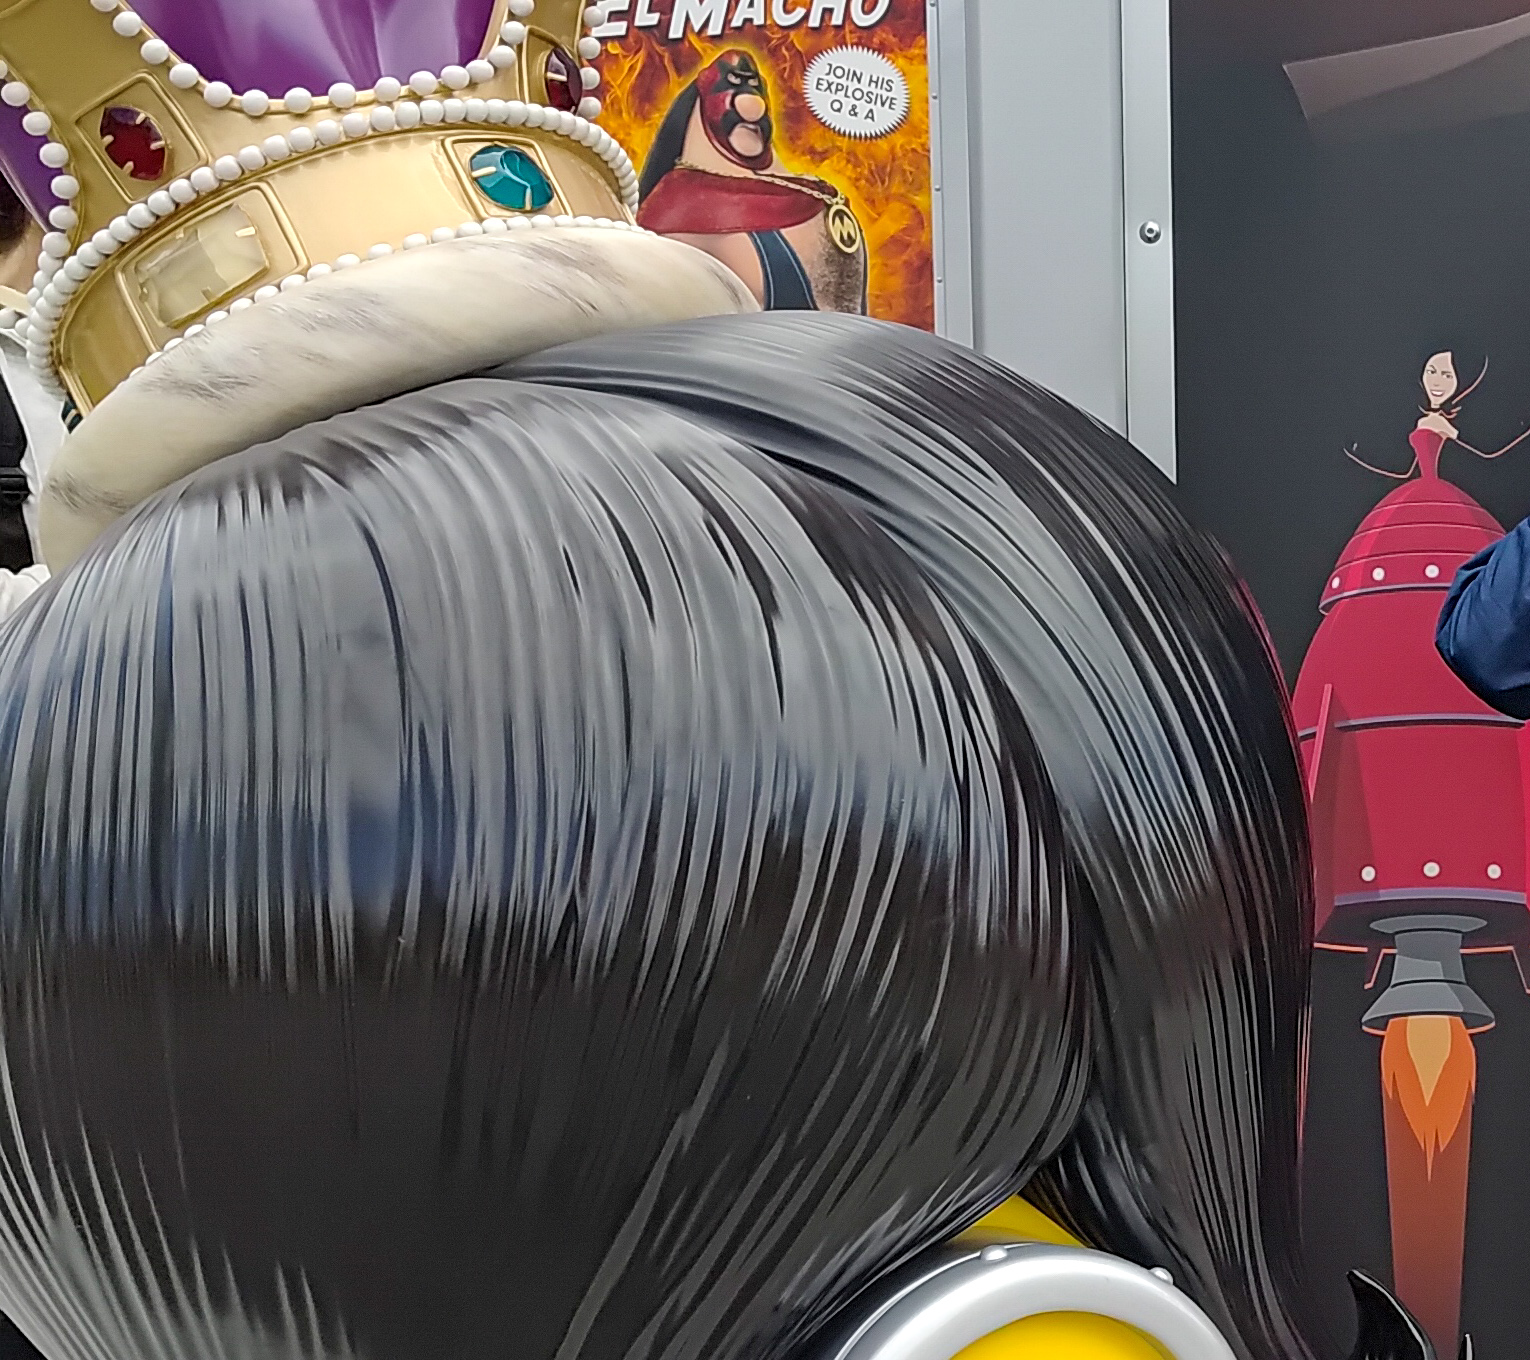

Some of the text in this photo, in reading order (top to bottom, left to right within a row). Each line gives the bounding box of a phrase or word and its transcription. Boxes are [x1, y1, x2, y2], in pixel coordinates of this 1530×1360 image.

[824, 63, 895, 93] JOIN HIS
[815, 77, 898, 111] EXPLOSIVE
[830, 99, 876, 123] Q & A
